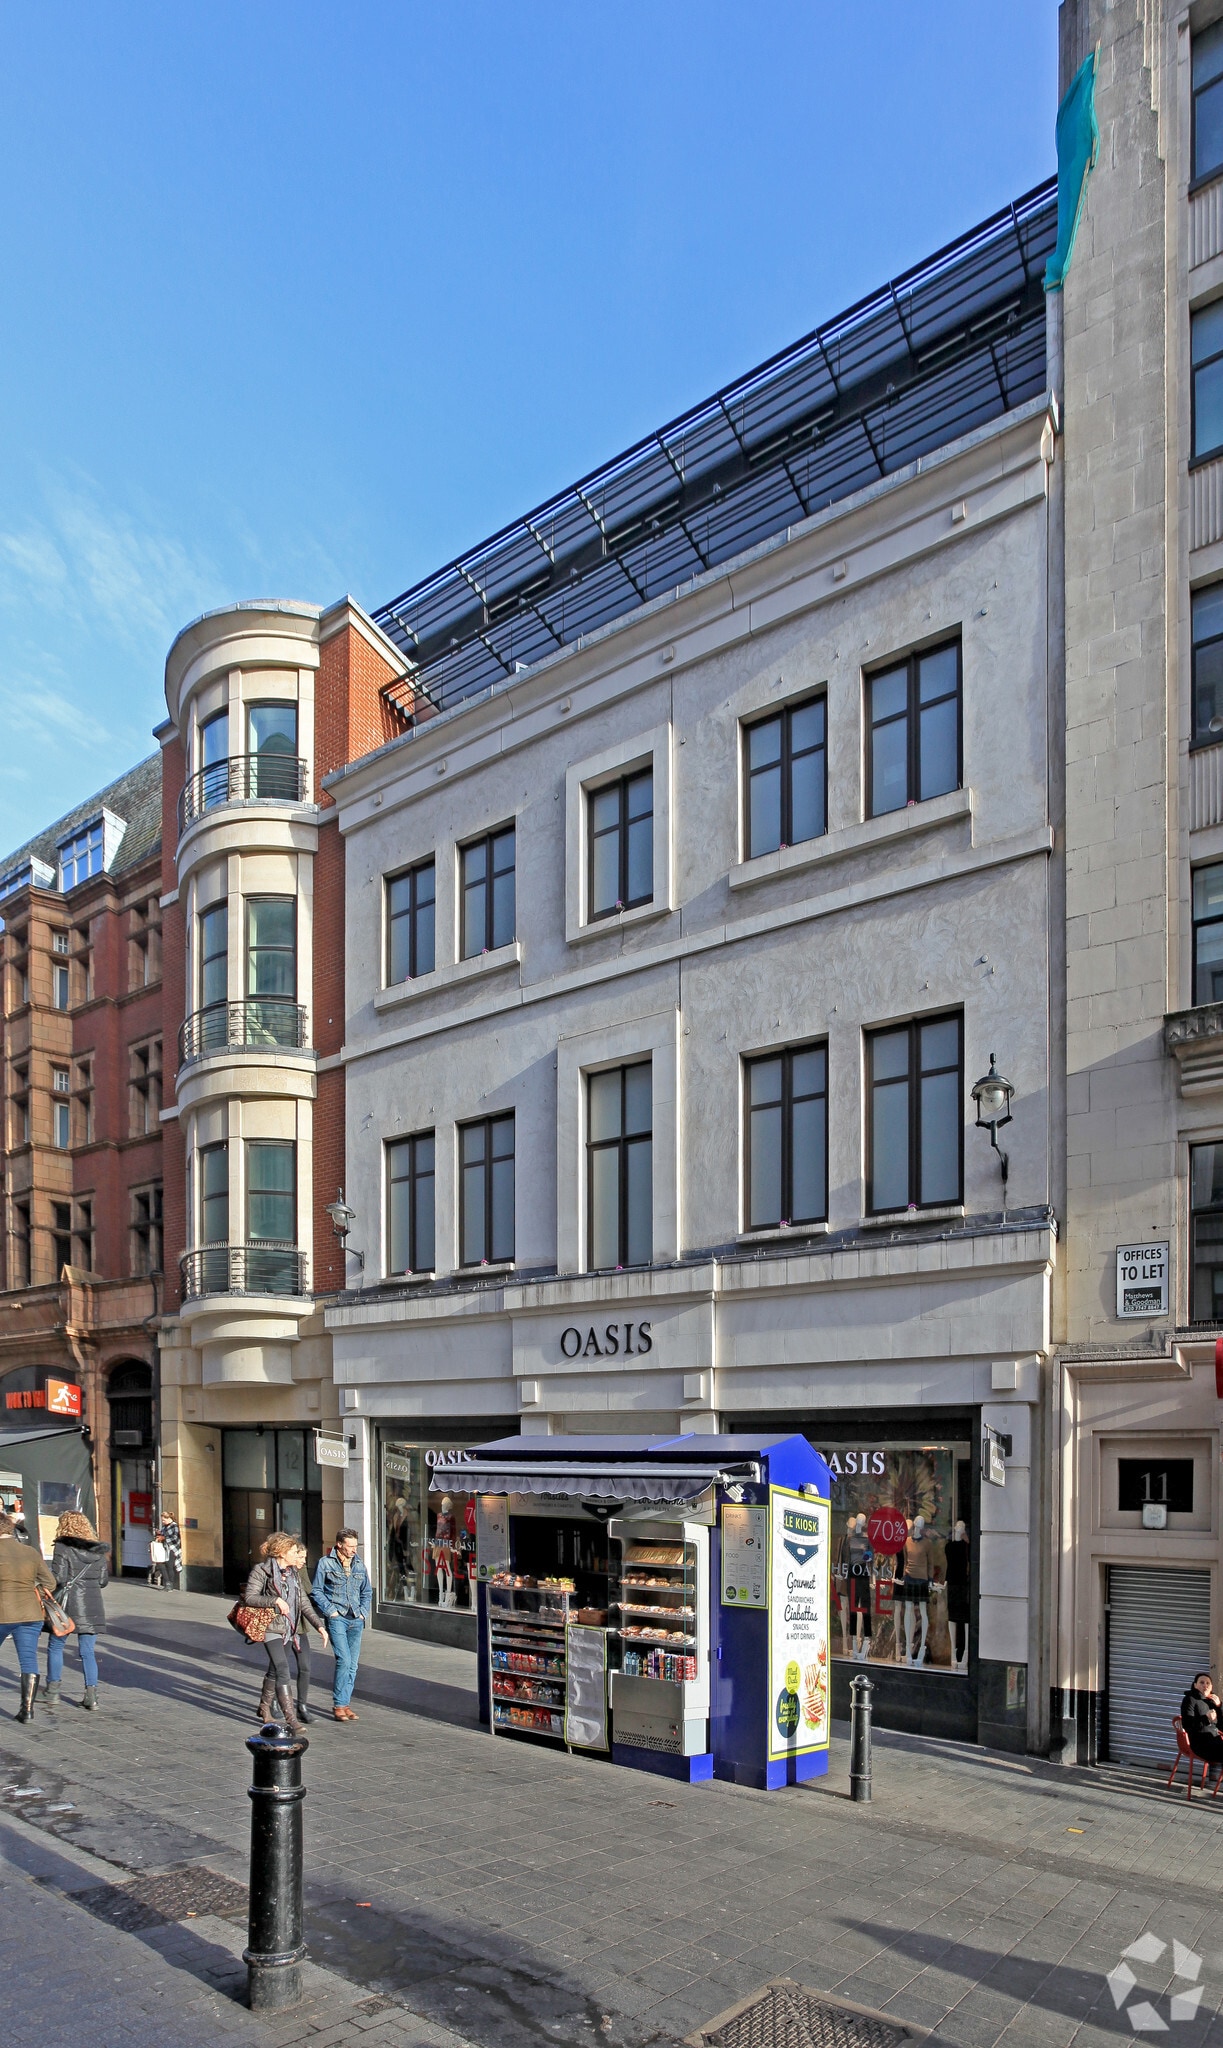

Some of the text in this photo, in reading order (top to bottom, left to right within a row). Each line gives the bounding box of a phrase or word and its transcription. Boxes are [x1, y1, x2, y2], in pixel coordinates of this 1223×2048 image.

[1124, 1248, 1162, 1261] OFFICES
[1121, 1264, 1165, 1280] TO LET
[560, 1322, 653, 1358] OASIS
[320, 1447, 346, 1459] OASIS
[816, 1451, 885, 1475] ASIS
[1141, 1472, 1171, 1501] 11
[785, 1515, 818, 1533] LE KIOSK
[870, 1519, 905, 1541] 70%
[437, 1538, 453, 1549] THE
[455, 1539, 476, 1551] OASI
[422, 1548, 477, 1580] SALE
[831, 1562, 849, 1575] HE
[787, 1572, 816, 1594] Gourmet
[788, 1595, 815, 1604] SANDWICHES
[784, 1604, 818, 1622] Ciabattas
[792, 1623, 810, 1631] SNACKS
[786, 1632, 790, 1640] &
[791, 1632, 800, 1640] HOT
